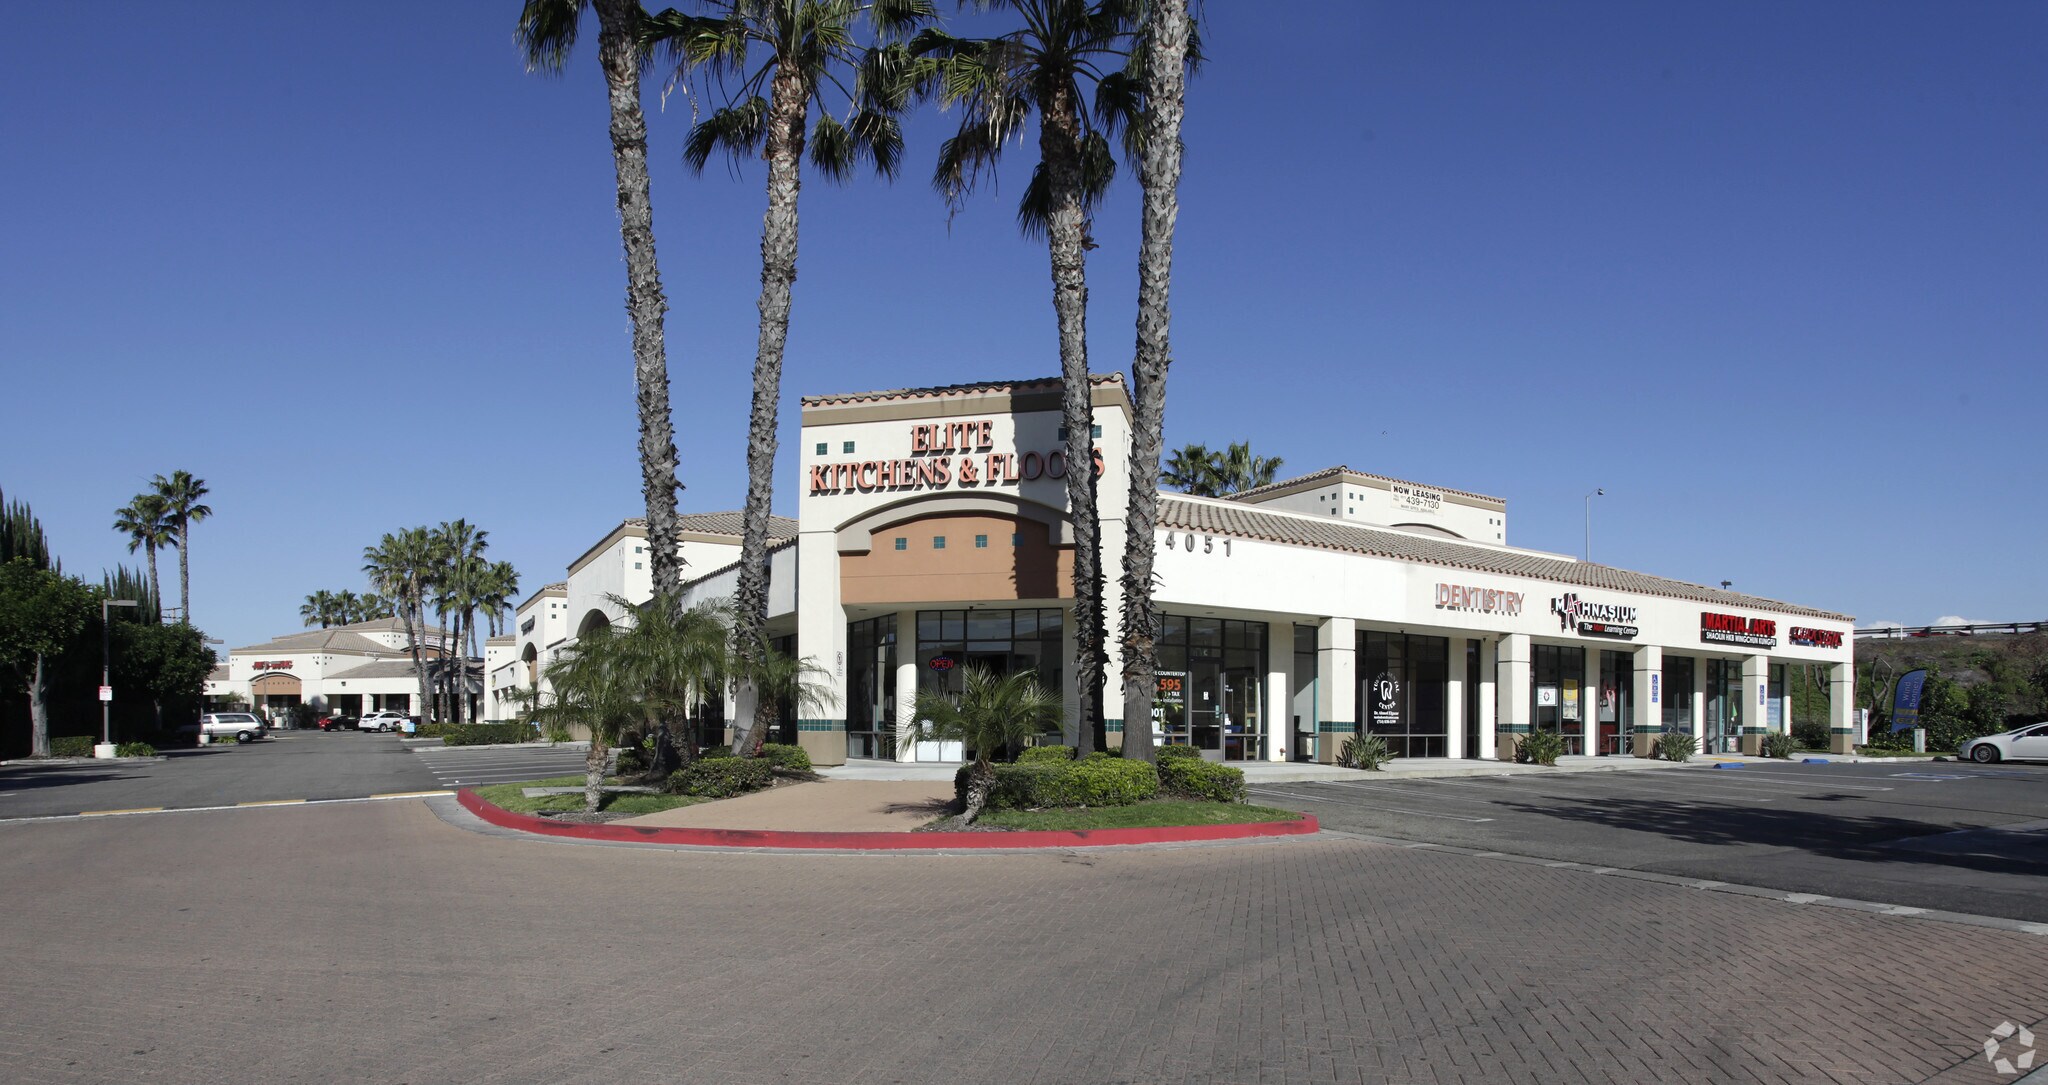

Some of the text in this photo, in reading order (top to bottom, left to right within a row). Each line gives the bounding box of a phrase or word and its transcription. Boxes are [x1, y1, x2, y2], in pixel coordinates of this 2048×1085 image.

[911, 419, 993, 452] ELITE
[809, 447, 1105, 491] KITCHENS & FLOOS
[1393, 485, 1409, 495] NOW
[1412, 489, 1441, 502] LEASING
[1405, 496, 1440, 510] 439-7130
[1437, 583, 1525, 613] DENTISTRY
[1583, 622, 1593, 631] The
[1605, 625, 1623, 636] Learning
[1623, 626, 1638, 635] Center
[1704, 612, 1777, 637] MARTIAL ARTS
[1706, 631, 1726, 641] SHAOLIN
[929, 659, 954, 669] OPEN
[1156, 678, 1181, 691] ,595
[1902, 681, 1911, 703] Wind
